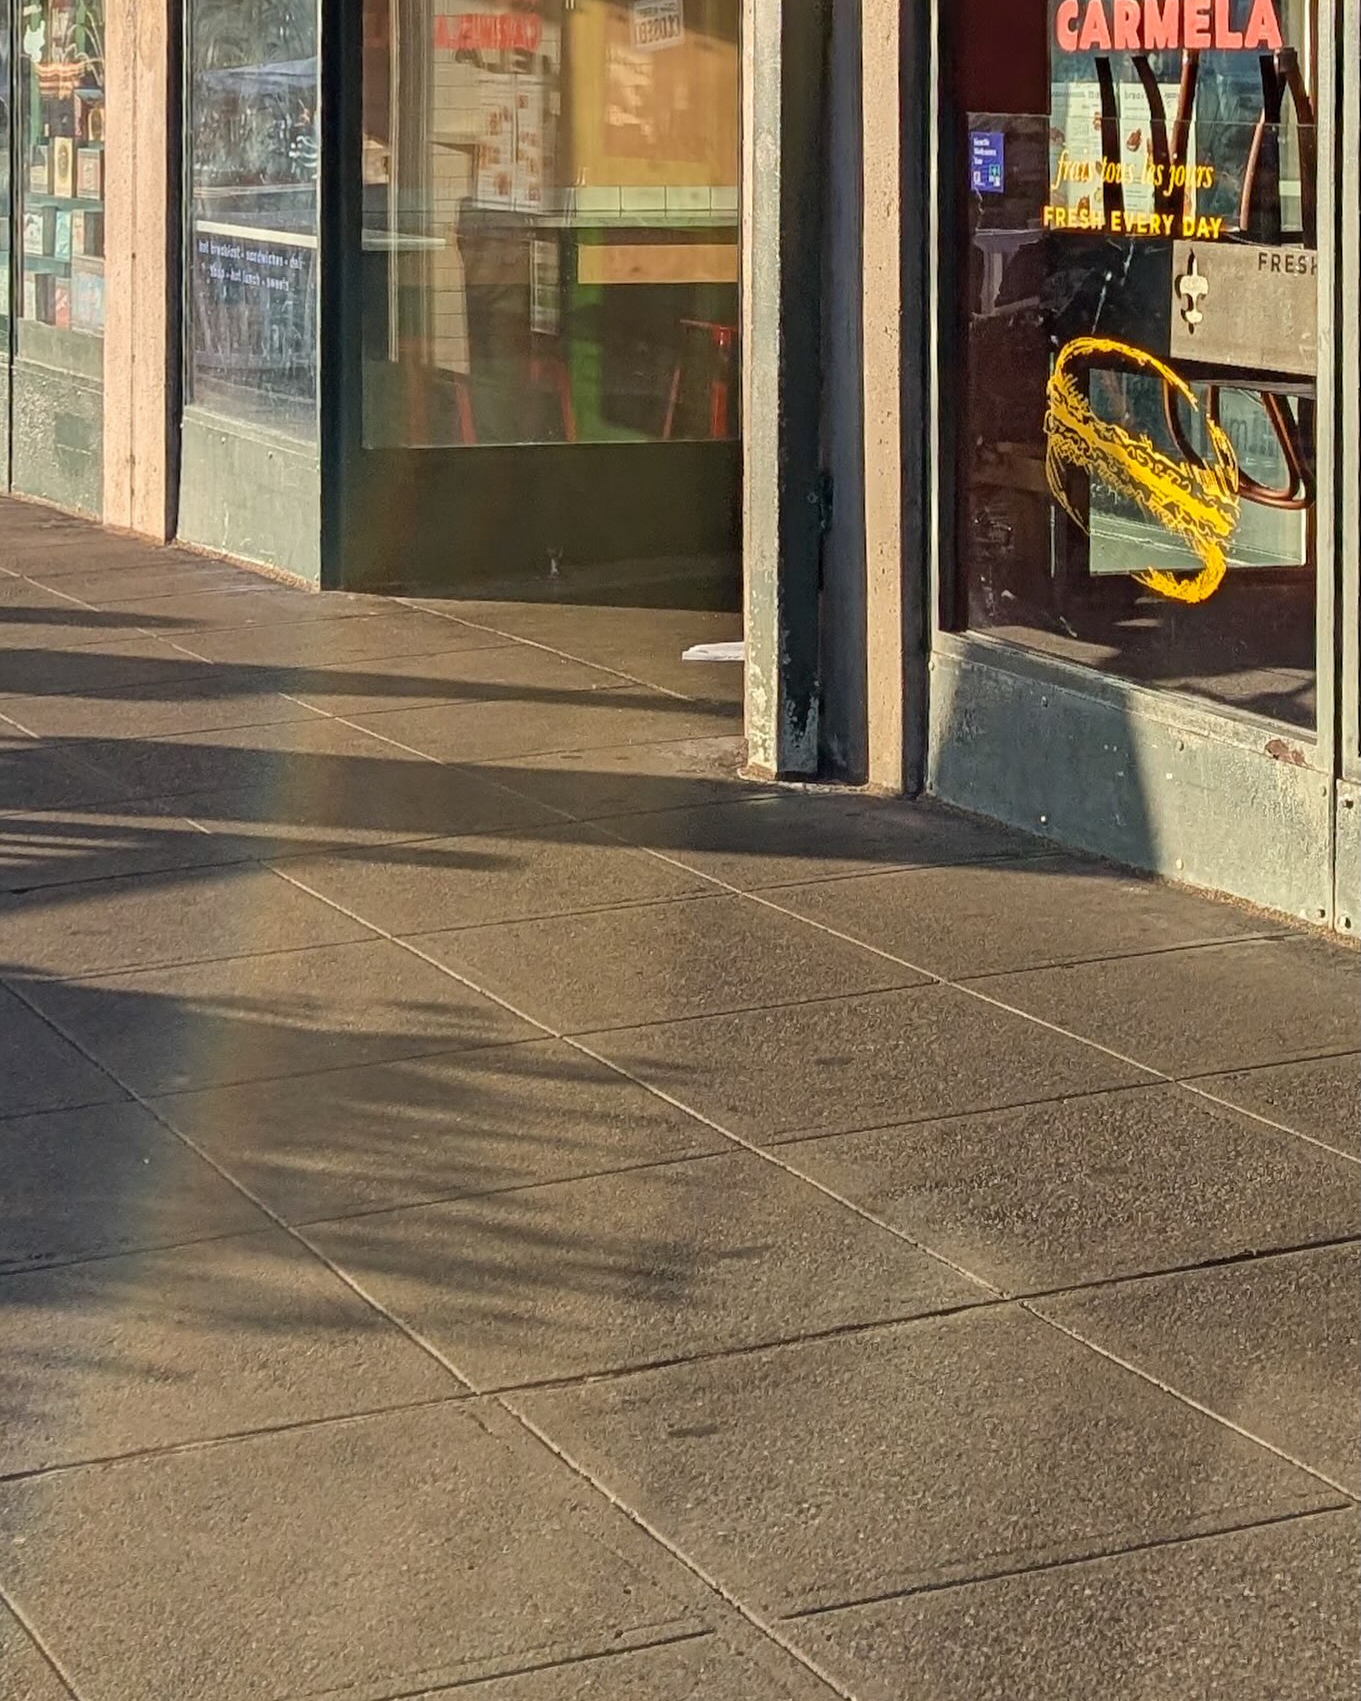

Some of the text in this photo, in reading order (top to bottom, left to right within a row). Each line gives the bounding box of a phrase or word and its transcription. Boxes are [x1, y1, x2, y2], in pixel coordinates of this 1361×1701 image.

[1051, 150, 1214, 197] frais tous les jours
[1043, 205, 1223, 239] FRESH EVERY DAY
